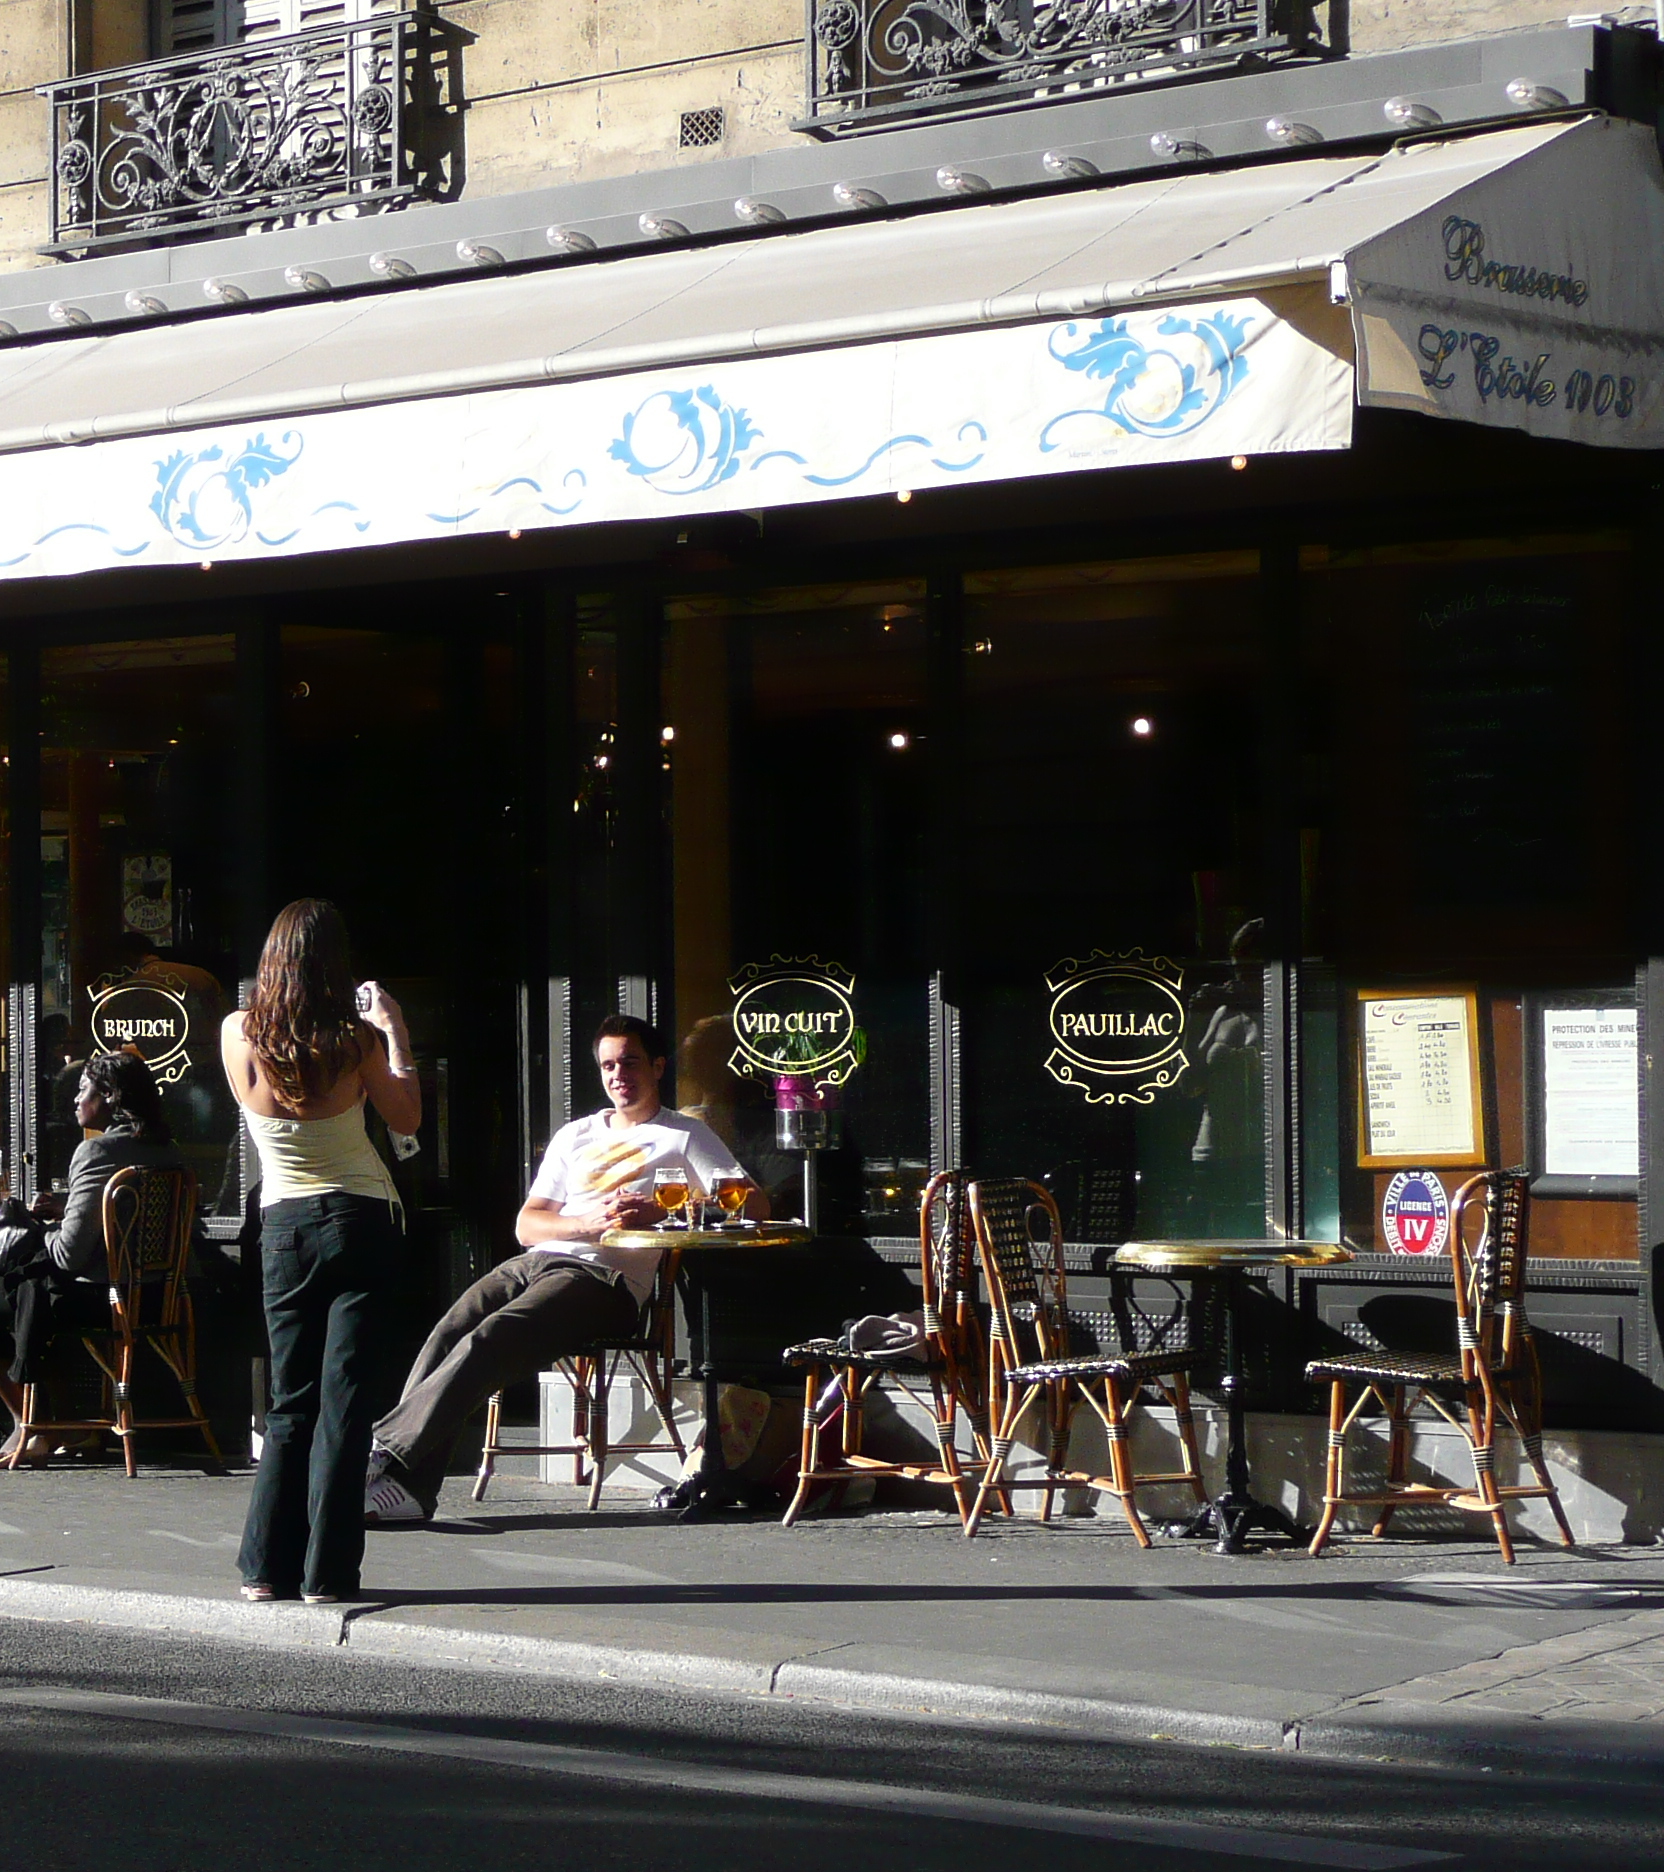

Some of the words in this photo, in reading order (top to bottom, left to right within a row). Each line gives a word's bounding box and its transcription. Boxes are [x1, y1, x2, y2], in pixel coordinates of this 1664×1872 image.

[1443, 215, 1587, 306] Brasserie
[1419, 324, 1557, 407] L'Etoile
[1565, 369, 1634, 418] 1903
[104, 1018, 176, 1040] BRUNCH
[741, 1011, 779, 1033] VIN
[784, 1008, 844, 1034] CUIT
[1061, 1012, 1174, 1036] PAUILLAC
[1552, 1025, 1596, 1034] PROTECTION
[1599, 1024, 1614, 1033] DES
[1387, 1172, 1409, 1205] VILLE
[1421, 1172, 1445, 1208] PARIS
[1400, 1201, 1432, 1212] LICENCE
[1403, 1218, 1429, 1241] IV
